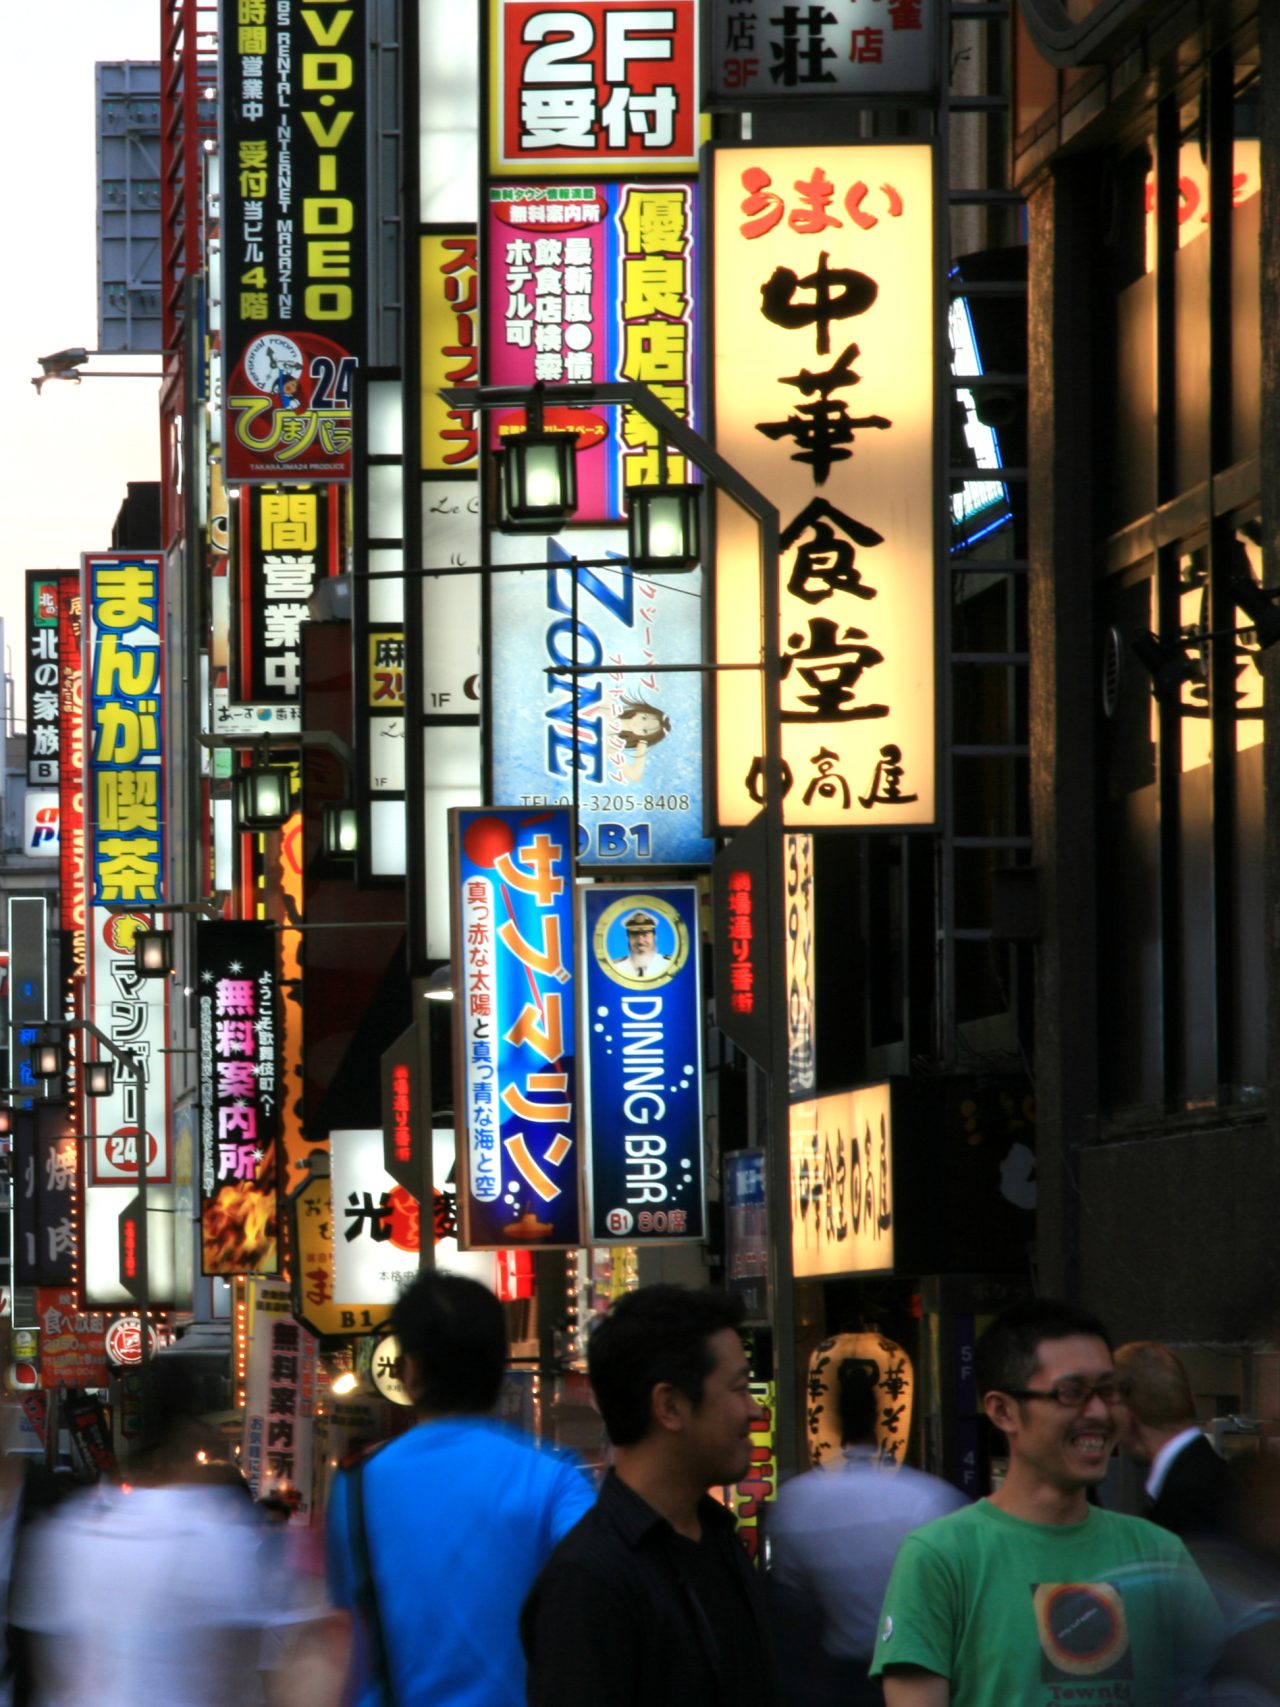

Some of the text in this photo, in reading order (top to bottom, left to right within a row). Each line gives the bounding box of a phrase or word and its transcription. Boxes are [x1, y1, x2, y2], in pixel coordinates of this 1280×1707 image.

[522, 9, 676, 82] 2F
[723, 58, 759, 88] 3F
[300, 0, 355, 321] VD・VIDEO
[519, 87, 677, 149] 受付
[276, 33, 292, 320] RENTAL INTERNET MAGAZINE
[489, 187, 597, 202] 無料タウン情報満載
[509, 204, 602, 225] 無料案内所
[740, 167, 904, 239] うまい
[239, 141, 268, 320] 受付当ビル4階
[505, 238, 534, 349] ホテル可
[533, 238, 565, 382] 飲食店検索
[310, 356, 358, 410] 24
[309, 463, 345, 471] PRODUCE
[755, 250, 893, 725] 中華食堂
[32, 628, 59, 755] 北の家族
[431, 692, 451, 708] 1F
[545, 536, 637, 785] ZONE
[93, 566, 158, 901] まんが喫茶
[375, 777, 387, 786] 1F
[599, 822, 653, 858] B1
[466, 881, 498, 1199] 真っ赤な太陽と真っ青な海と空
[493, 833, 572, 1202] サブマリン
[215, 978, 257, 1181] 無料案内所
[620, 996, 668, 1206] DINING BAR
[609, 1208, 687, 1234] B1 80席
[340, 1310, 374, 1329] B1
